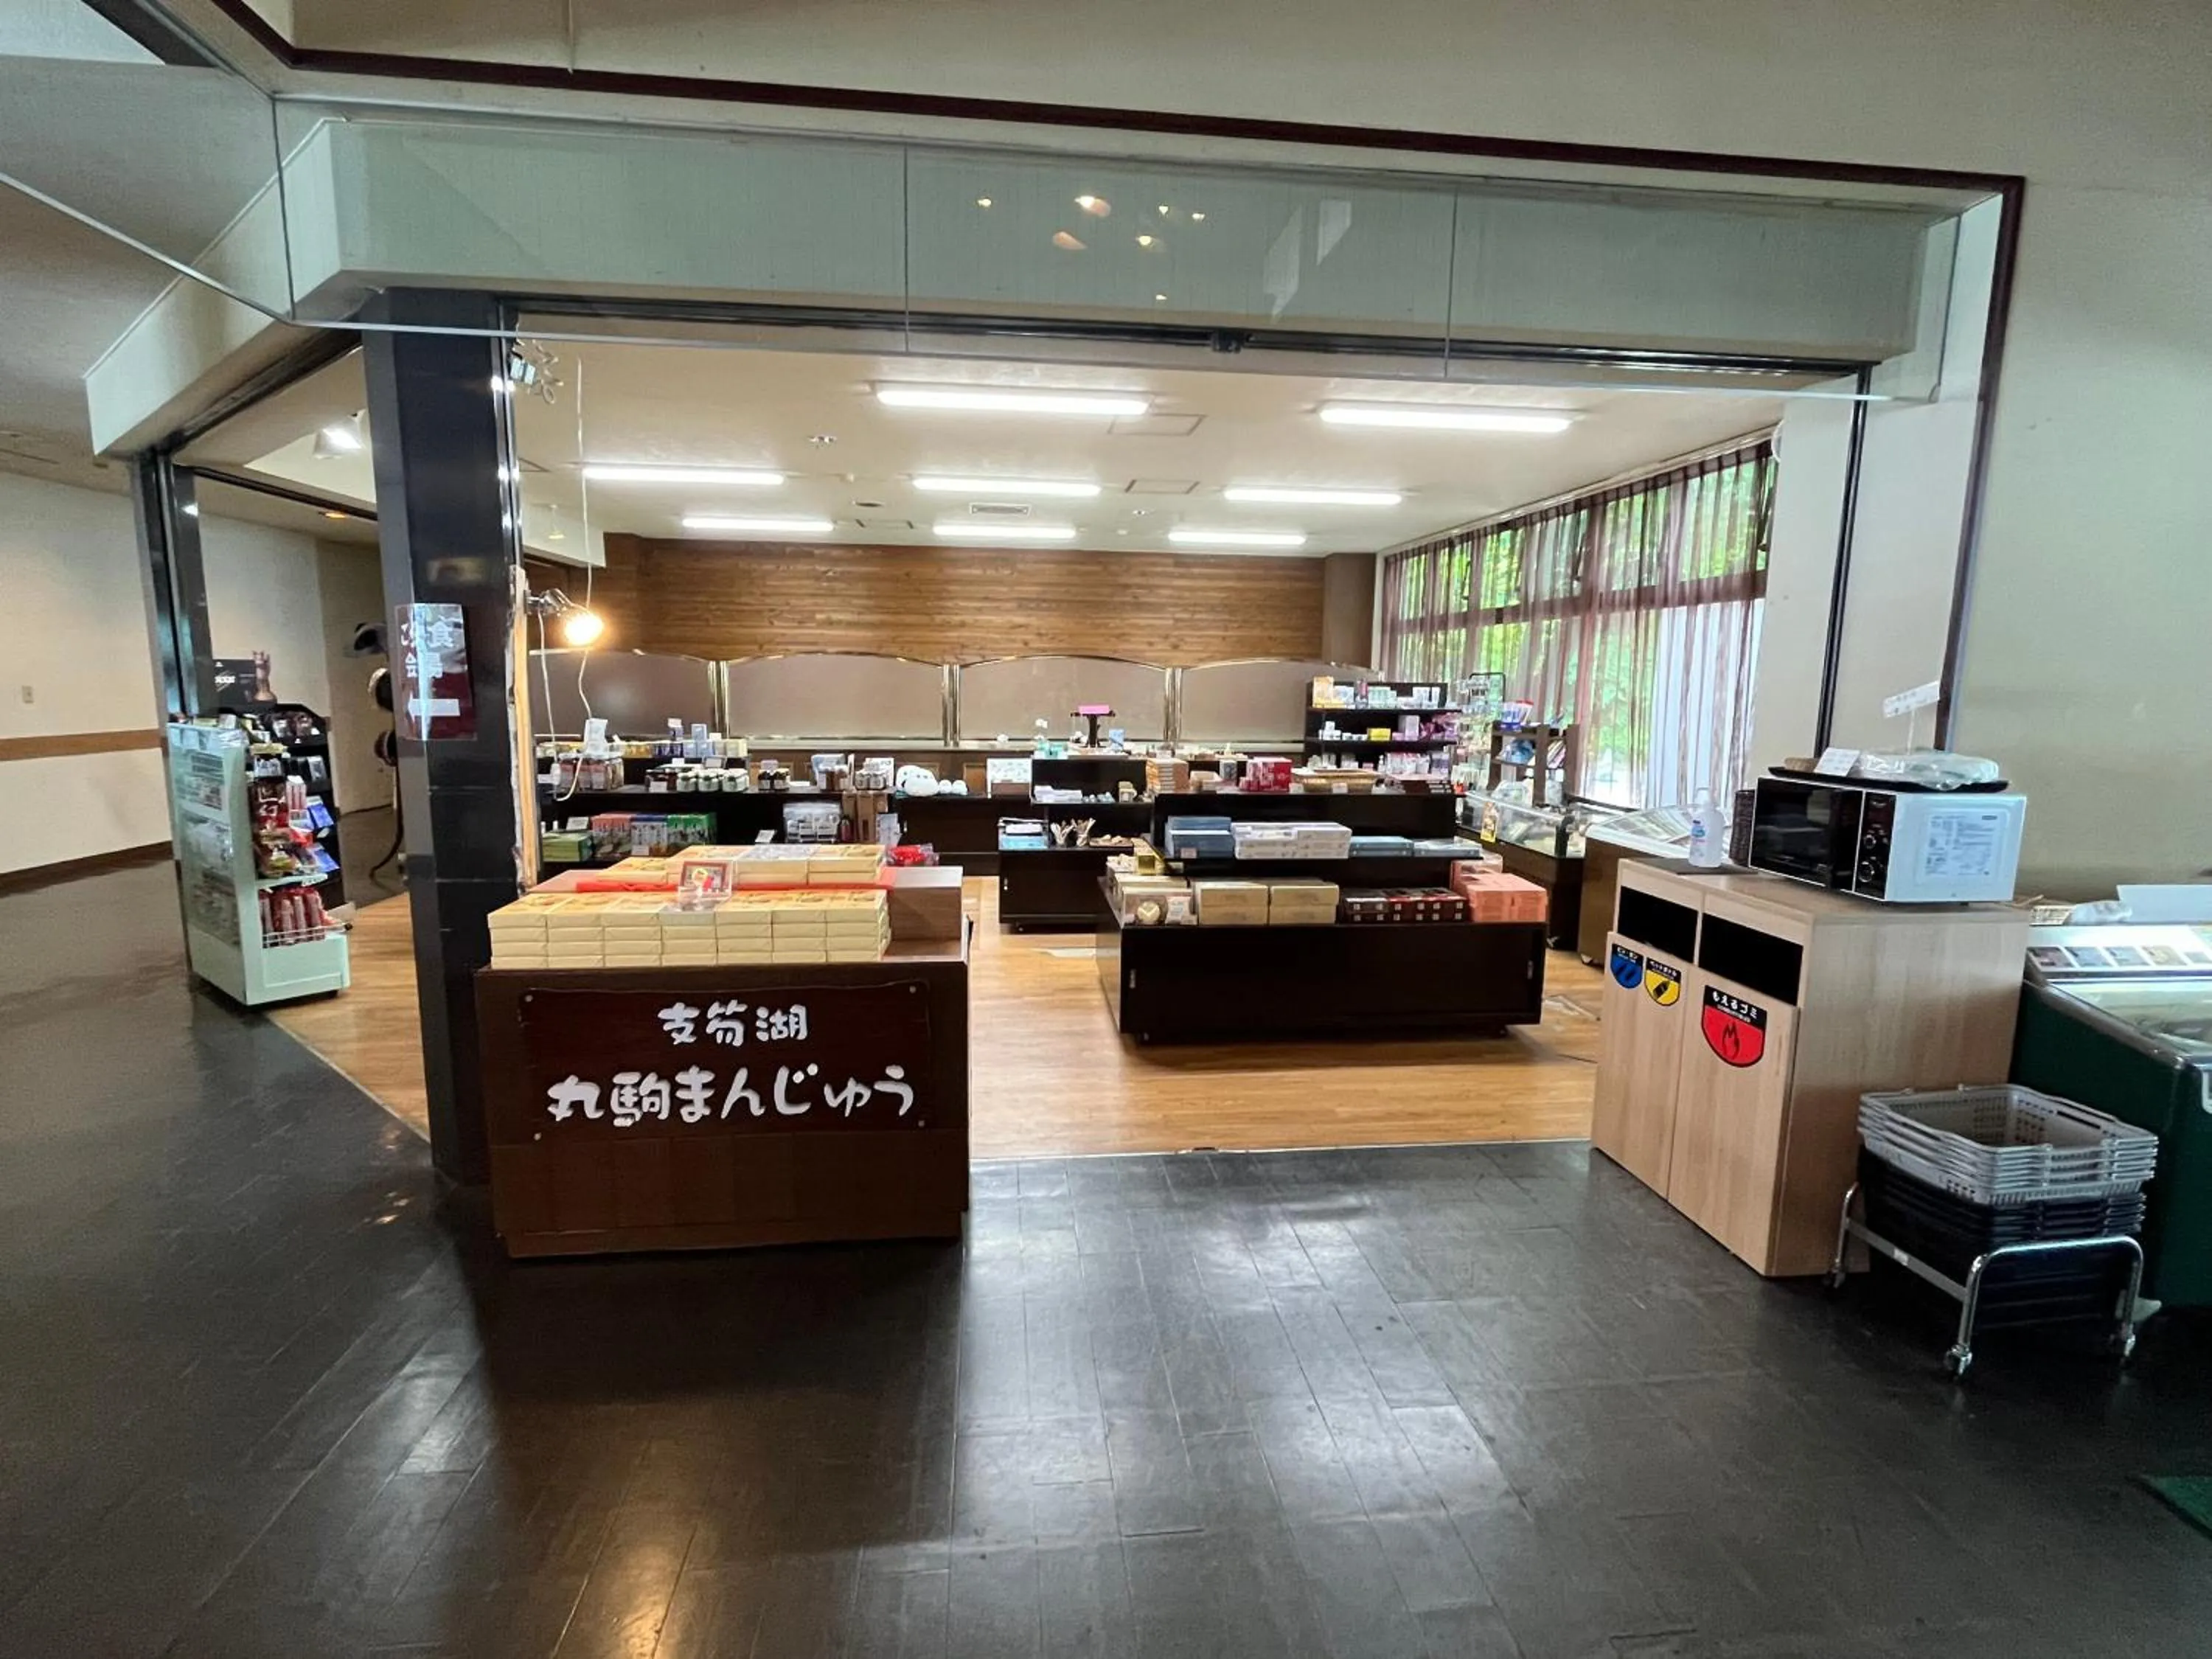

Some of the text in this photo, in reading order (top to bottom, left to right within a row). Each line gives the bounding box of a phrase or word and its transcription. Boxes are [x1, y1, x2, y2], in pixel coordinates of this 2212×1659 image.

[657, 998, 809, 1047] 支笏湖
[1712, 990, 1758, 1020] もえるゴミ
[546, 1062, 915, 1127] 丸駒まんじゅう
